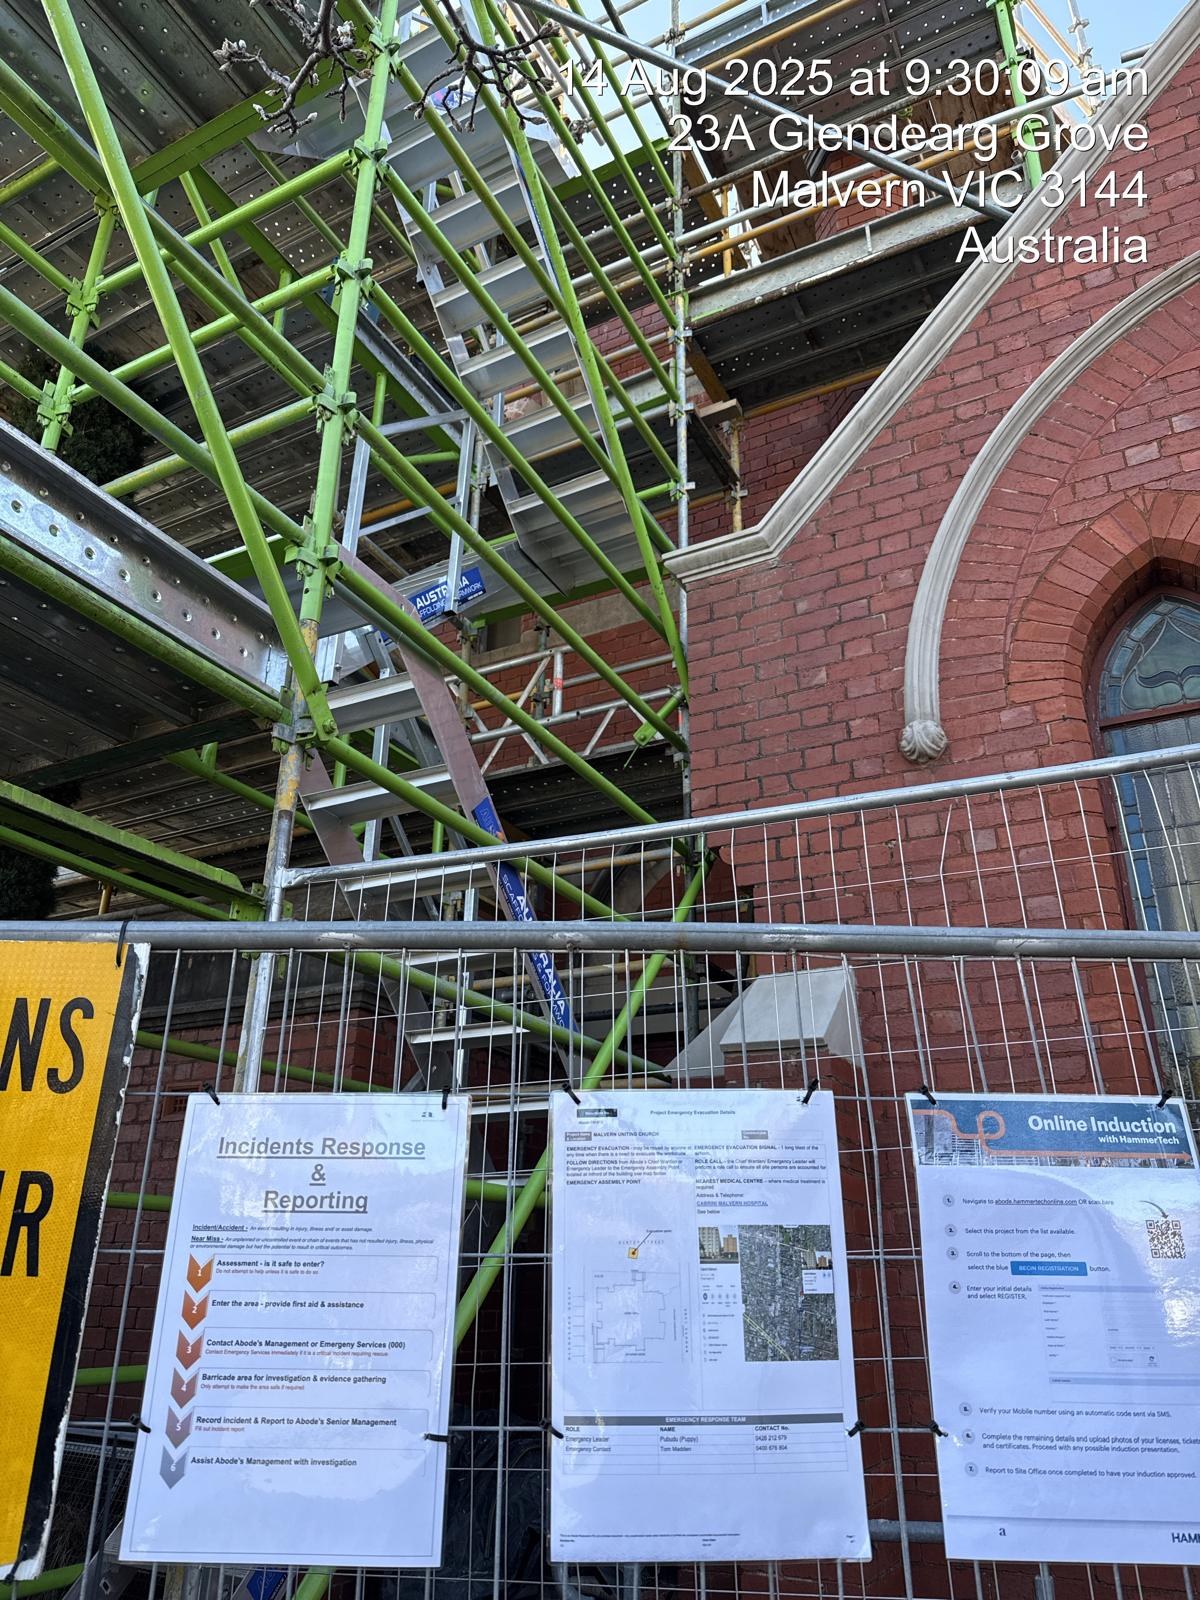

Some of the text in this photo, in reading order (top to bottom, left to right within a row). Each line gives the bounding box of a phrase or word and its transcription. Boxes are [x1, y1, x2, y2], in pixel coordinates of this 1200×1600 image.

[1027, 1115, 1177, 1134] Online Induction
[1098, 1135, 1180, 1145] with HammerTech
[218, 1136, 426, 1158] Incidents Response
[311, 1163, 326, 1183] &
[263, 1190, 368, 1213] Reporting
[265, 1301, 291, 1309] provide
[265, 1340, 308, 1348] Management
[388, 1341, 405, 1349] (000)
[266, 1375, 310, 1383] investigation
[353, 1376, 386, 1384] gathering
[261, 1417, 285, 1425] Report
[351, 1418, 397, 1427] Management
[246, 1458, 291, 1466] Management
[311, 1459, 357, 1467] investigation
